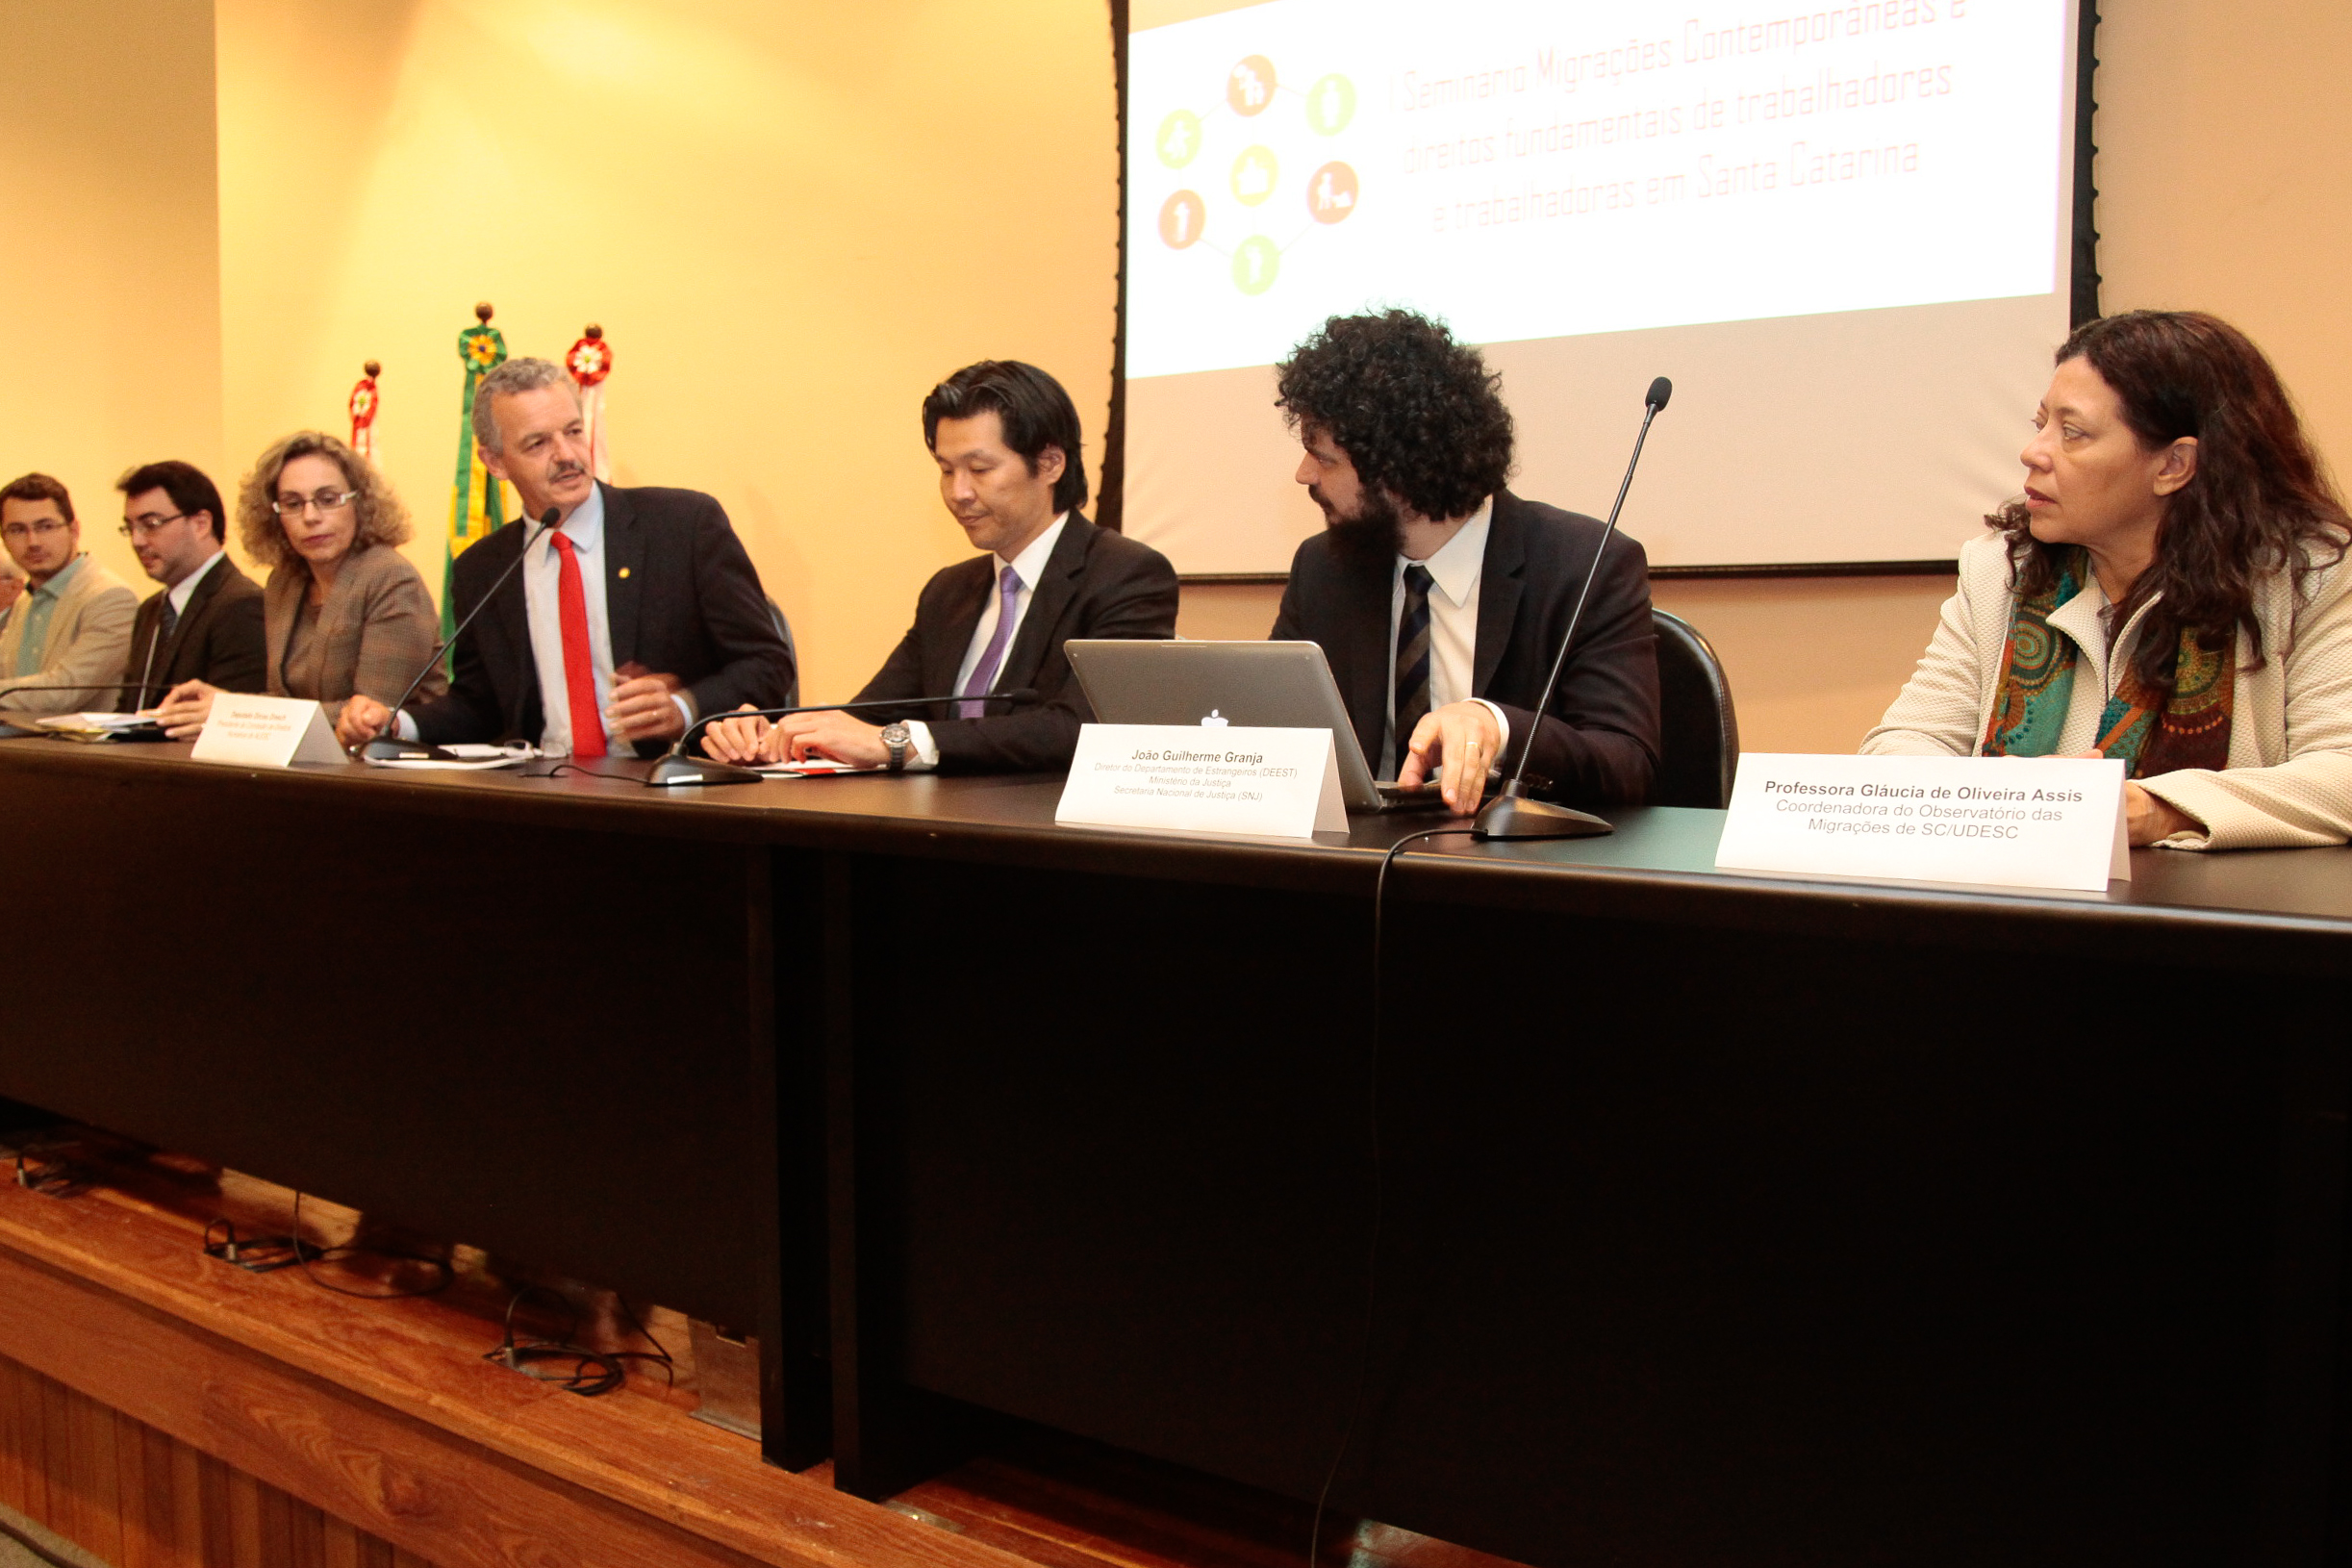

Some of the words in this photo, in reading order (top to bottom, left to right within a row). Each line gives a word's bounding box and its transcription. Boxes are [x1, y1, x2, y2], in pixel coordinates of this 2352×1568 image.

[1536, 38, 1673, 94] Migrações
[1404, 134, 1496, 174] direitos
[1505, 101, 1683, 159] fundamentais
[1693, 87, 1726, 131] de
[1737, 60, 1954, 125] trabalhadores
[1431, 206, 1447, 233] e
[1454, 174, 1636, 231] trabalhadoras
[1646, 172, 1686, 206] em
[1697, 154, 1778, 198] Santa
[1789, 137, 1921, 188] Catarina
[1131, 748, 1159, 761] João
[1162, 750, 1221, 763] Guilherme
[1225, 751, 1263, 766] Granja
[1094, 762, 1121, 772] Diretor
[1123, 764, 1132, 773] do
[1134, 764, 1191, 775] Departamento
[1193, 766, 1203, 775] de
[1205, 767, 1257, 777] Estrangeiros
[1259, 768, 1298, 779] (DEEST)
[1149, 775, 1188, 786] Ministério
[1189, 776, 1201, 787] da
[1201, 778, 1231, 789] Justiça
[1764, 780, 1855, 797] Professora
[1860, 783, 1924, 798] Gláucia
[1930, 785, 1952, 799] de
[1958, 786, 2026, 801] Oliveira
[2032, 788, 2084, 802] Assis
[1114, 785, 1154, 797] Secretaria
[1156, 788, 1193, 798] Nacional
[1194, 789, 1204, 799] de
[1206, 790, 1236, 801] Justiça
[1237, 791, 1263, 802] (SNJ)
[1776, 798, 1888, 816] Coordenadora
[1893, 802, 1914, 818] do
[1919, 804, 2026, 821] Observatório
[2032, 807, 2063, 822] das
[1808, 818, 1891, 835] Migrações
[1895, 821, 1916, 835] de
[1921, 822, 2019, 840] SC/UDESC
